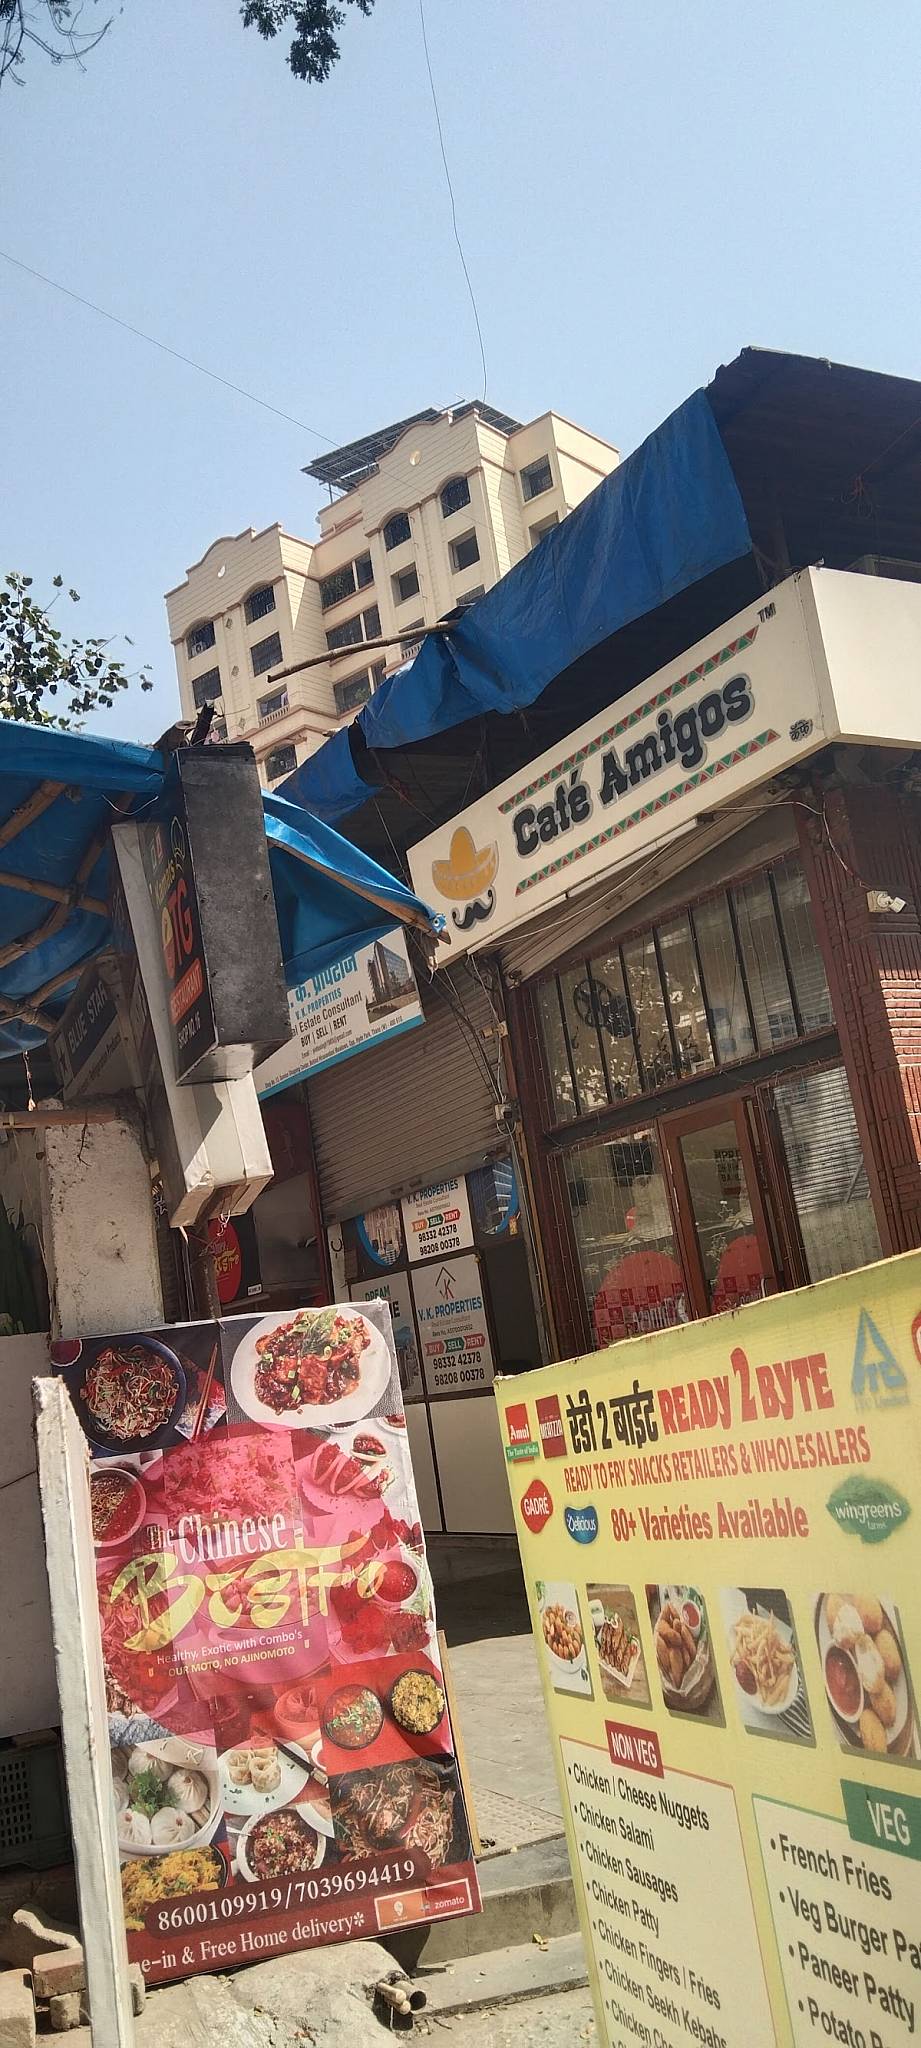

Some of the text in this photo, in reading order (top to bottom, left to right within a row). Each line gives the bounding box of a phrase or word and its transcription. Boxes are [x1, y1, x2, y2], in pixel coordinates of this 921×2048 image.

[756, 602, 777, 623] TM
[513, 673, 755, 857] Café Amigos
[299, 1014, 321, 1033] Estate
[322, 991, 363, 1020] Consultant
[308, 987, 342, 1014] PROPERTIES
[68, 1013, 88, 1054] BLUE
[301, 1034, 311, 1047] BUY
[316, 1026, 329, 1039] SELL
[333, 1015, 348, 1030] RENT
[420, 1179, 459, 1200] PROPERTIES
[415, 1211, 458, 1231] BUY SELL RENT
[419, 1223, 458, 1242] 98332 42378
[419, 1239, 460, 1256] 98208 00378
[435, 1297, 483, 1317] PROPERTIES
[428, 1336, 483, 1352] BUY SELL RENT
[433, 1352, 482, 1370] 98332 42378
[434, 1368, 485, 1386] 98208 00378
[657, 1347, 835, 1435] READY 2 BYTE
[510, 1423, 530, 1440] Amul
[596, 1401, 612, 1450] 2
[609, 1380, 659, 1449] बाईट
[564, 1425, 871, 1493] READY TO FRY SNACKS RETAILERS & WHOLESALERS
[523, 1492, 550, 1516] GADRÉ
[567, 1514, 596, 1532] Delicious
[611, 1497, 809, 1542] 80+ Varieties Available
[835, 1501, 902, 1524] wingreens
[147, 1511, 288, 1565] The Chinese
[157, 1629, 303, 1665] Healthy, Exotic with Combo's
[168, 1646, 295, 1677] OUR MOTO, NO AJINOMOTO
[610, 1731, 658, 1769] NON VEG
[574, 1763, 611, 1796] Chicken
[617, 1779, 658, 1812] Cheese
[659, 1791, 710, 1832] Nuggets
[580, 1801, 655, 1851] Chicken Salami
[866, 1800, 911, 1846] VEG
[586, 1839, 679, 1903] Chicken Sausages
[779, 1833, 892, 1901] French Fries
[158, 1858, 416, 1932] 8600109919/7039694419
[434, 1896, 465, 1910] zomato
[591, 1879, 660, 1938] Chicken Patty
[787, 1886, 822, 1934] Veg
[823, 1900, 888, 1955] Burger
[182, 1946, 195, 1965] &
[200, 1939, 237, 1961] Free
[240, 1928, 288, 1952] Home
[598, 1919, 638, 1960] Chicken
[639, 1943, 681, 1986] Fingers
[688, 1969, 721, 2011] Fries
[605, 1959, 645, 2004] Chicken
[646, 1984, 681, 2026] Seekh
[798, 1940, 915, 2034] Paneer Patty
[612, 1999, 652, 2047] Chicken
